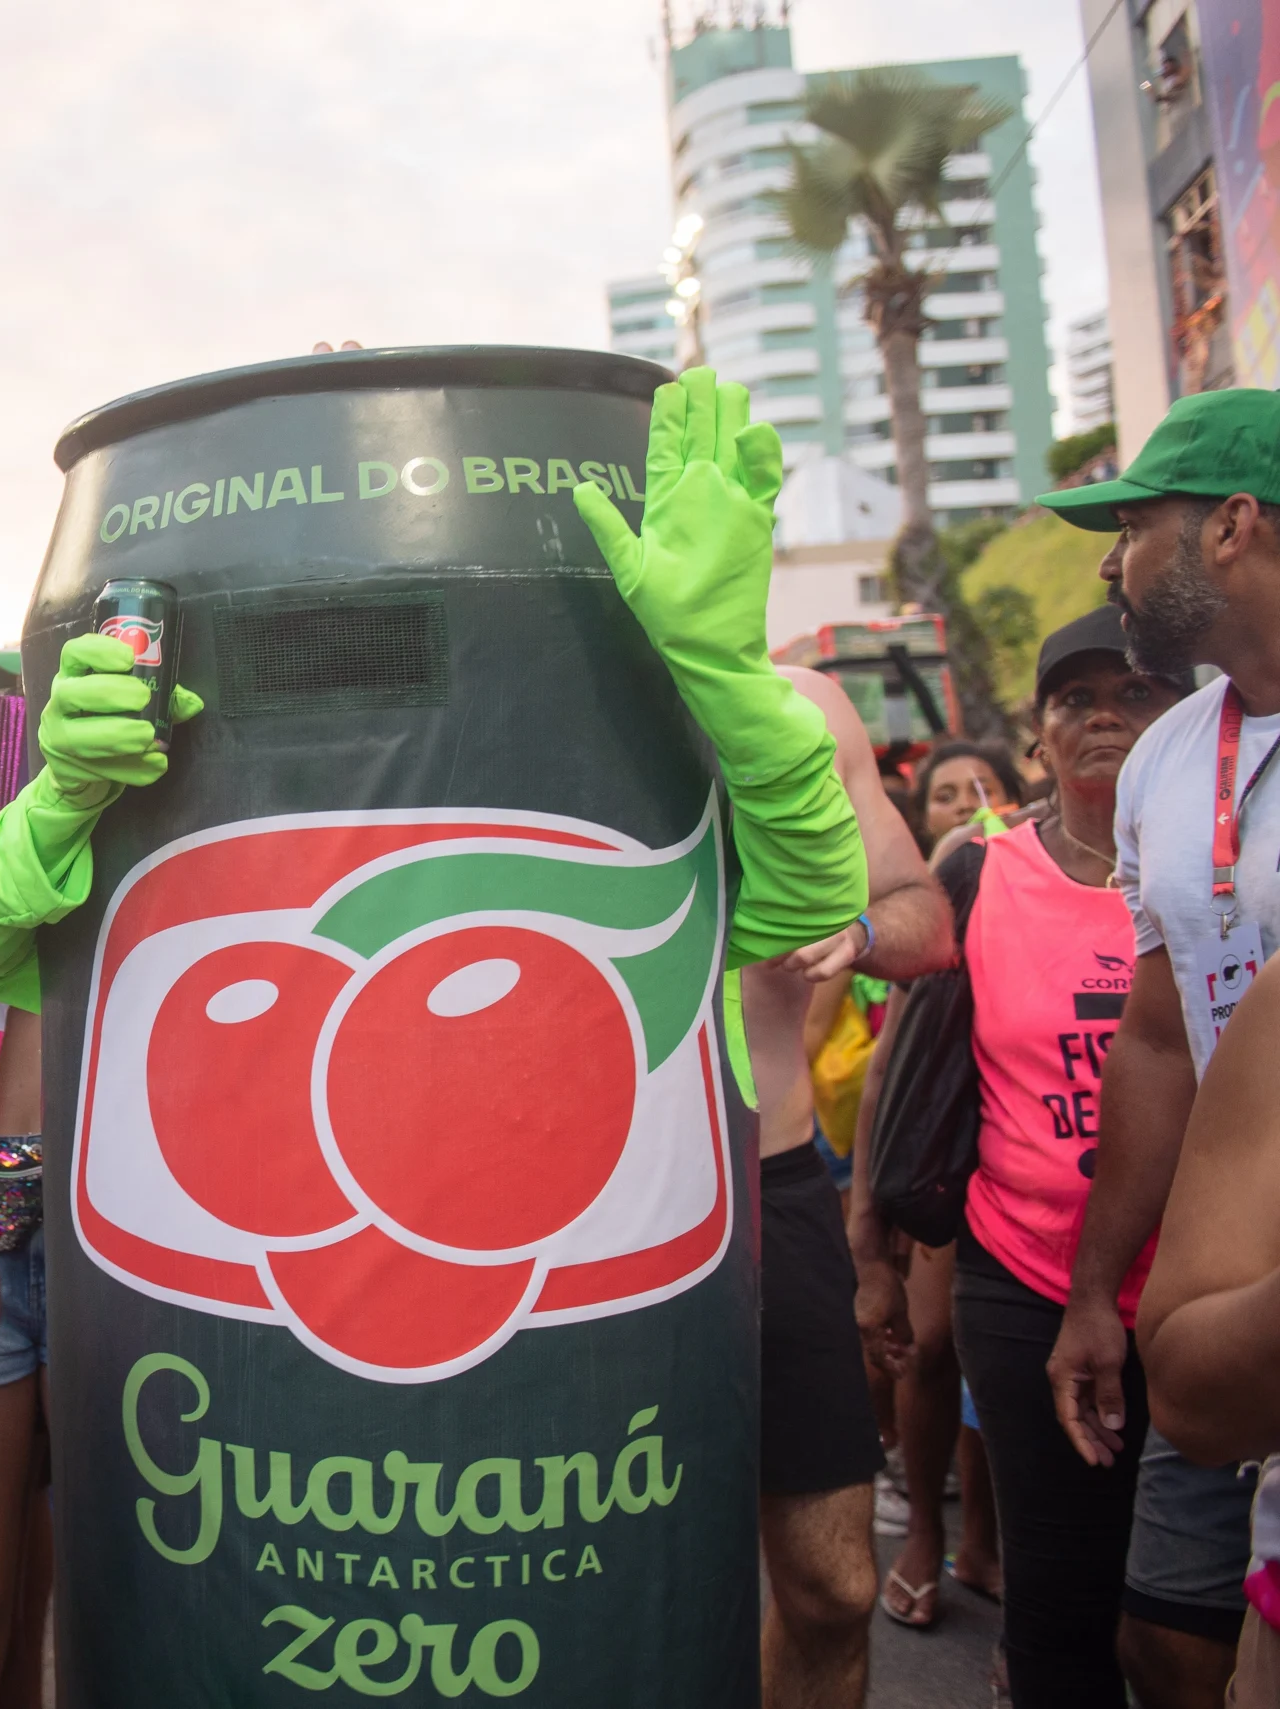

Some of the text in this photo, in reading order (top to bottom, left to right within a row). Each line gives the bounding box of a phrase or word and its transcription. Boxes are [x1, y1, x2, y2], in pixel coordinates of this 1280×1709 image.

[100, 456, 645, 543] ORIGINAL DO BRASIL
[122, 1352, 683, 1565] Guaraná
[255, 1542, 604, 1590] ANTARCTICA
[261, 1604, 541, 1698] zero
